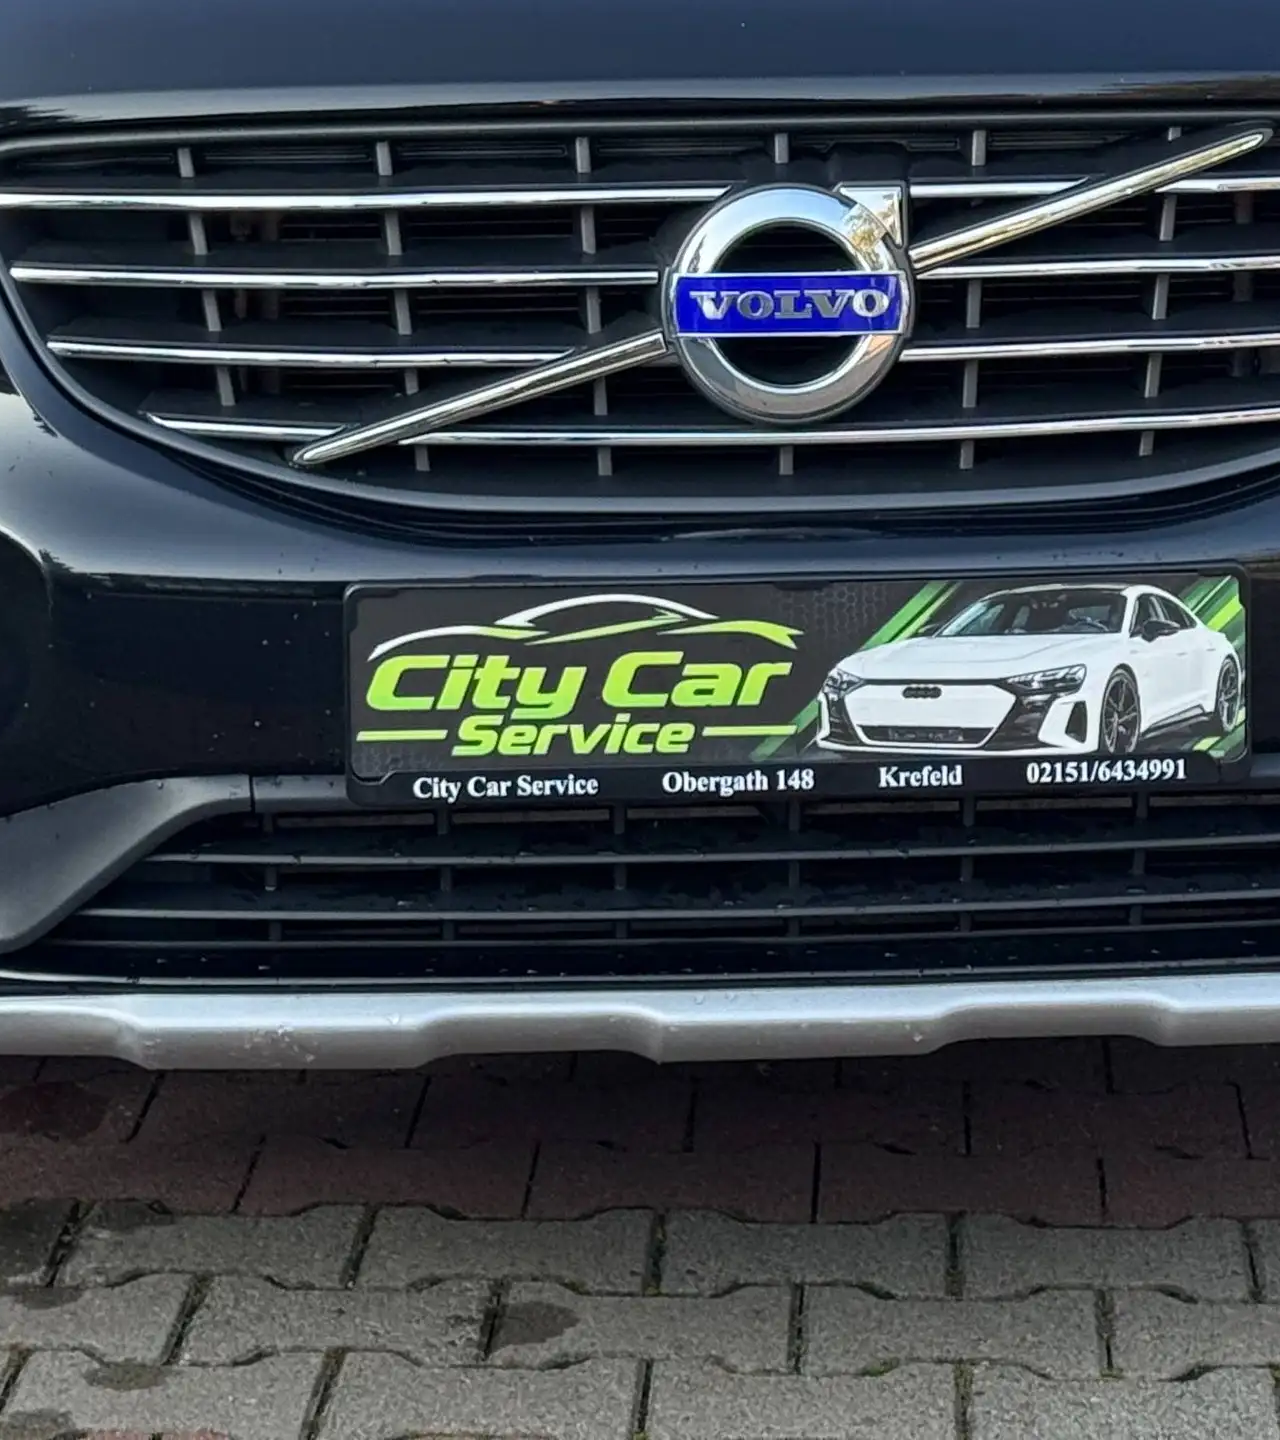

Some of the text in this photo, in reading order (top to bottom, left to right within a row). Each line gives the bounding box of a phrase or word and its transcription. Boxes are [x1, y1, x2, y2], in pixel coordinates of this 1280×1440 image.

[690, 288, 890, 320] VOLVO
[366, 650, 793, 720] City Car
[451, 713, 695, 757] Service
[412, 758, 1188, 804] City Car Service Obergath 148 Krefeld 02151/6434991
